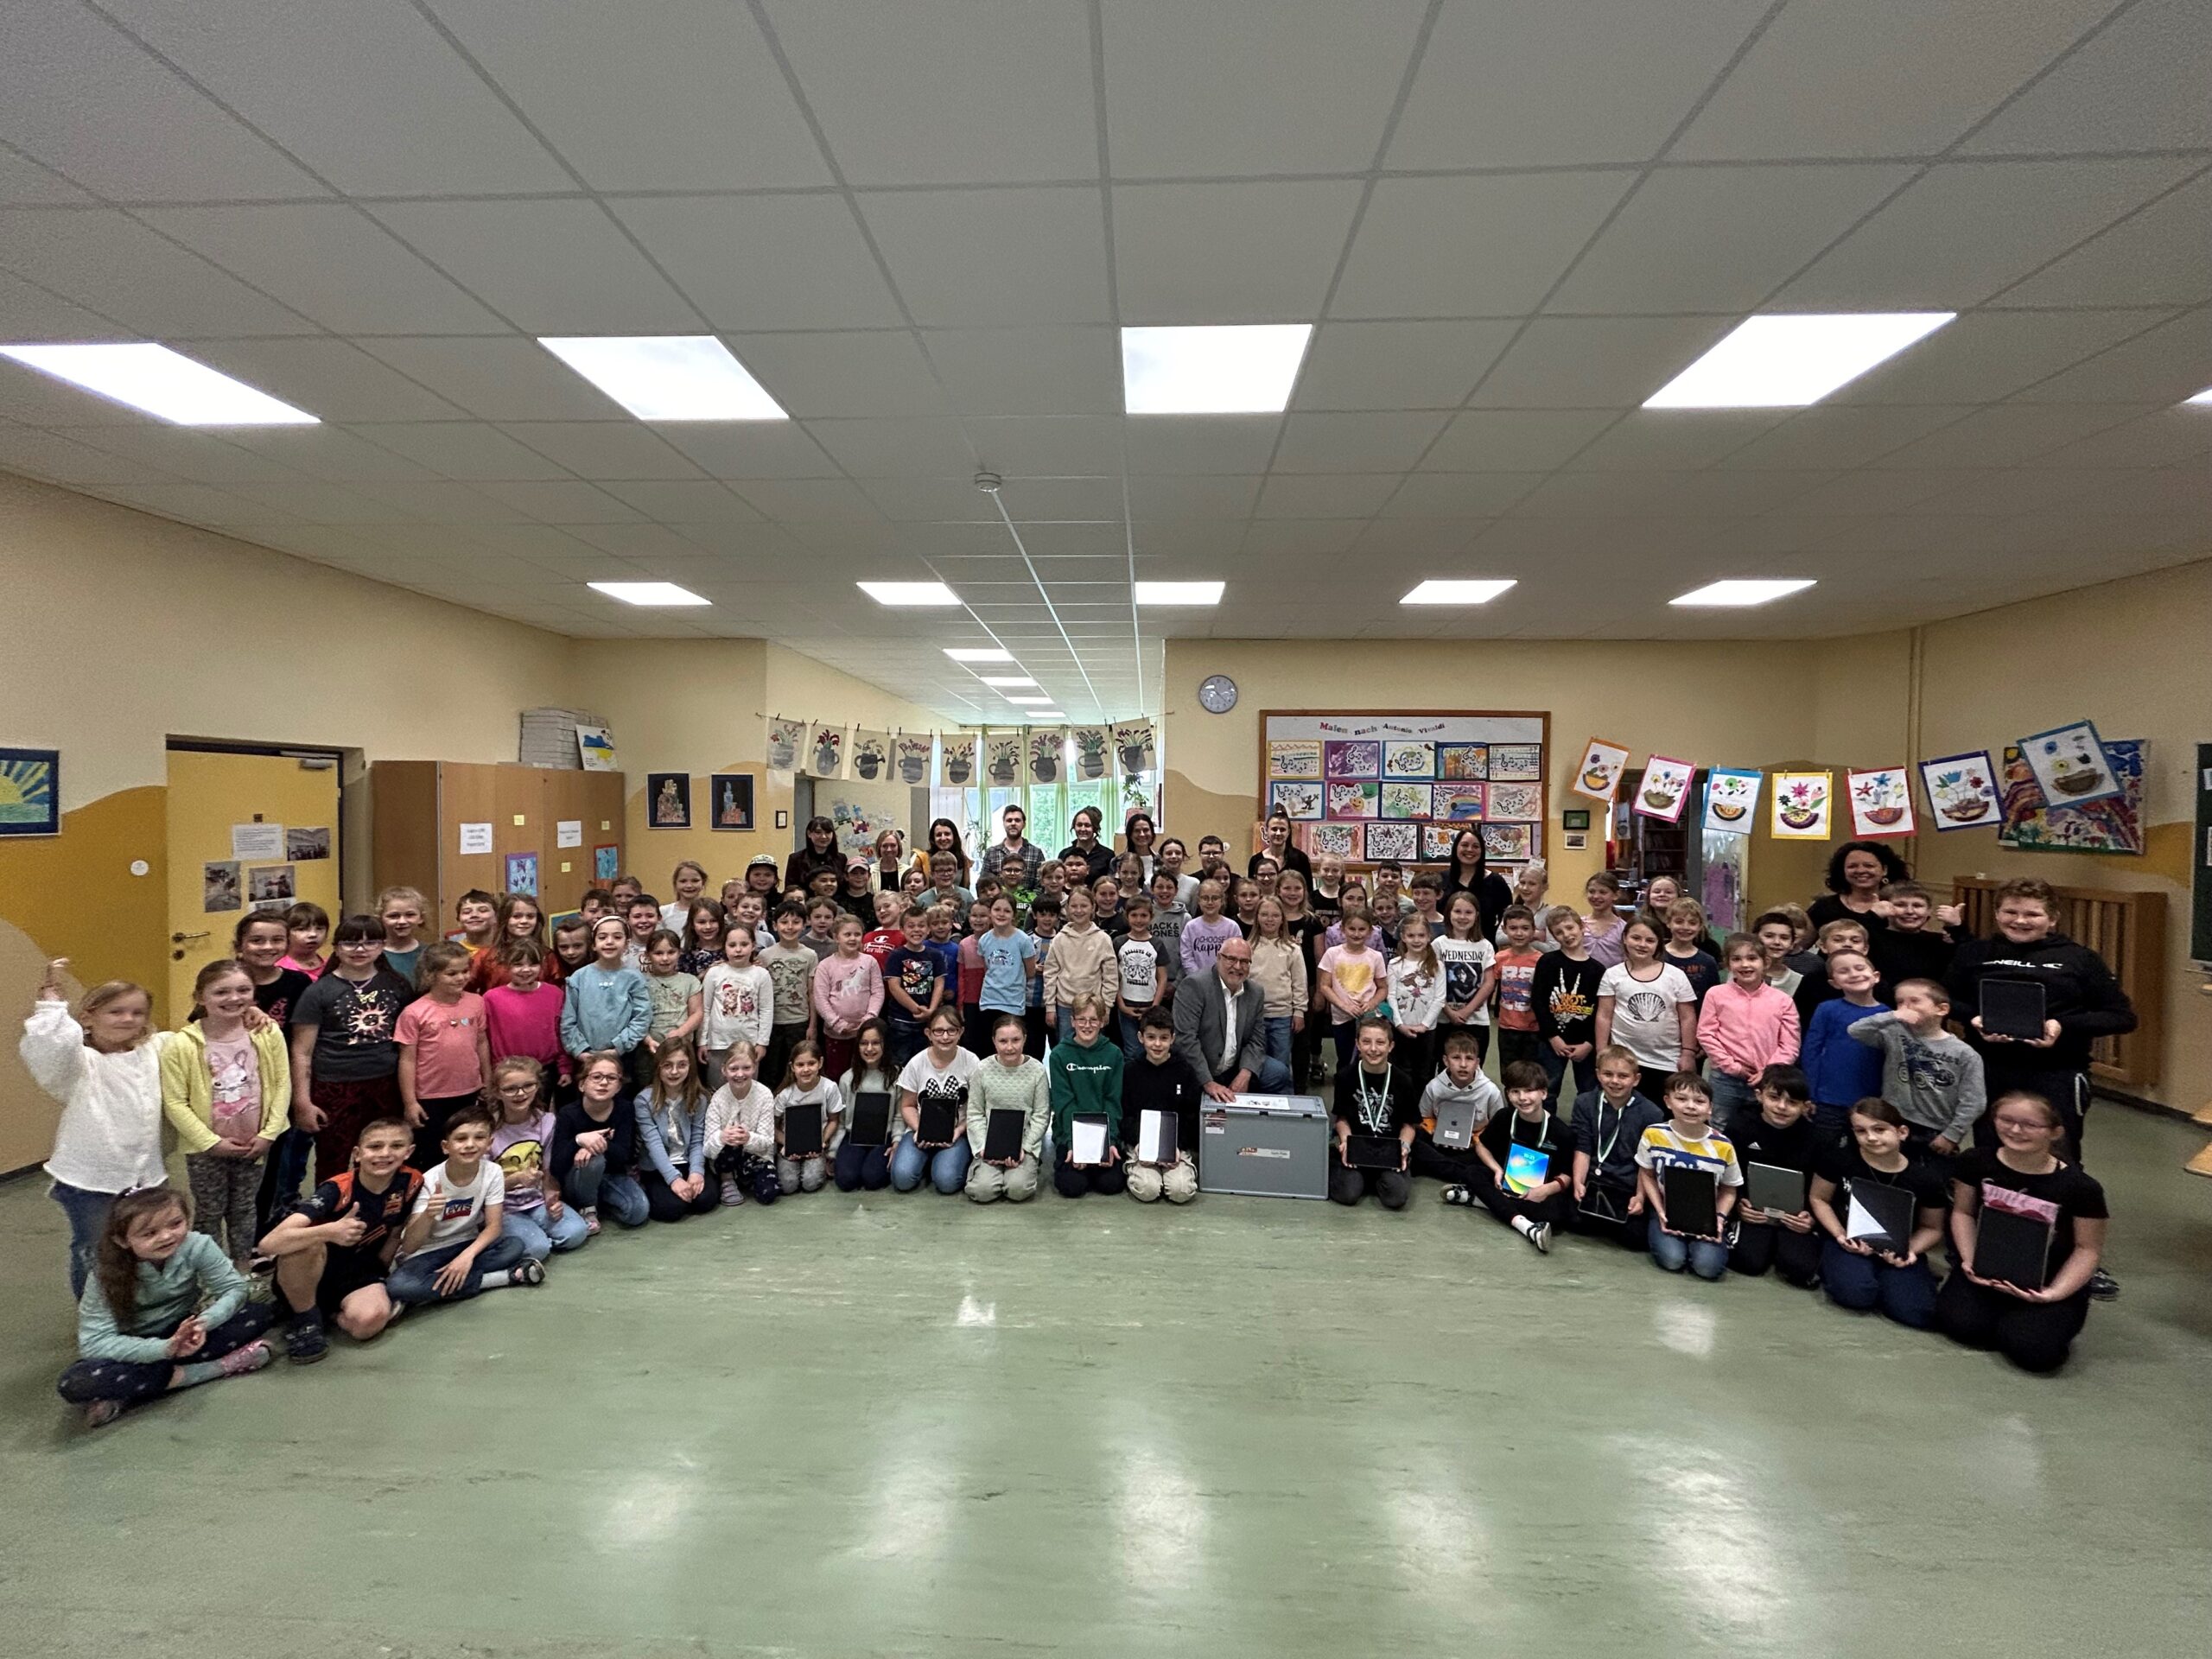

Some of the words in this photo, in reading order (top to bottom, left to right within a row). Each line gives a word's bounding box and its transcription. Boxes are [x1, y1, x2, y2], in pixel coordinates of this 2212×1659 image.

[1319, 722, 1348, 734] Malen
[1354, 725, 1378, 736] nach
[1382, 722, 1413, 734] Antonio
[1193, 938, 1223, 957] happ
[1441, 950, 1485, 961] WEDNESDAY
[1065, 1062, 1112, 1074] Champion
